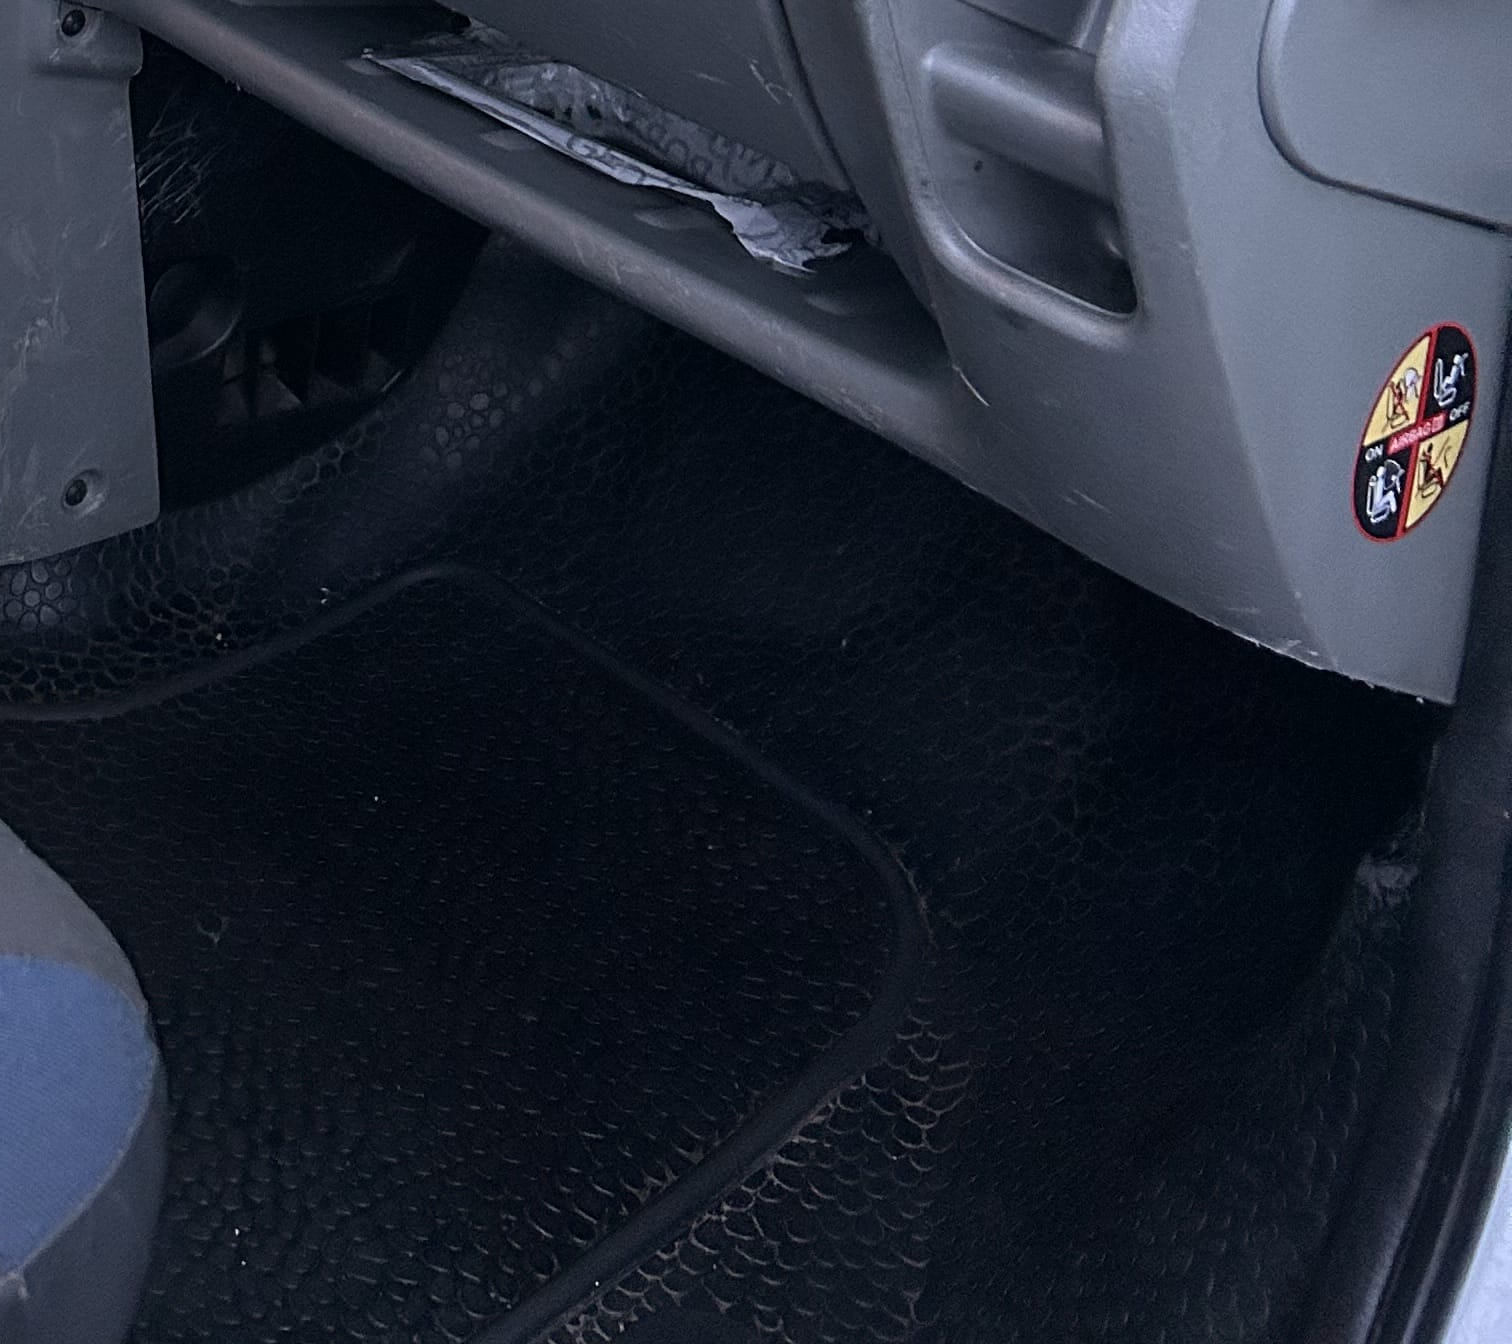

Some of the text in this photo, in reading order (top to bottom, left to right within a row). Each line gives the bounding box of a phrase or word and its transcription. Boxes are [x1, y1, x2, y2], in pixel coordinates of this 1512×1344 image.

[1365, 401, 1471, 462] ON AIRBAG OFF
